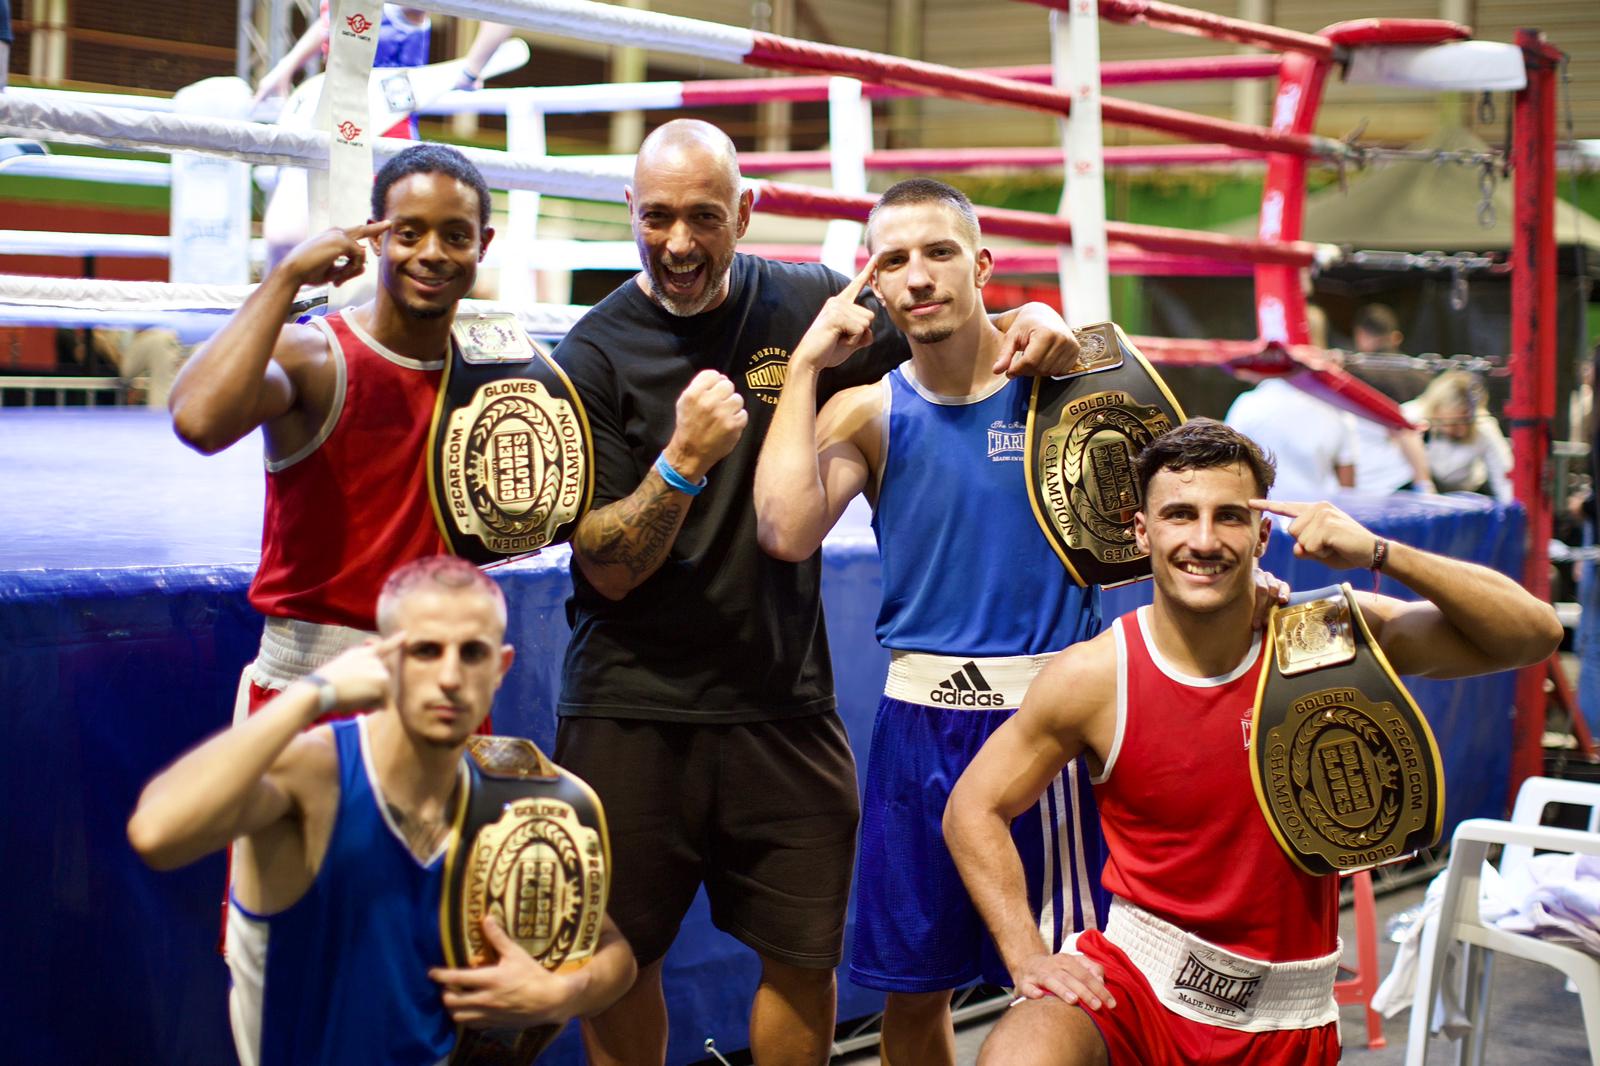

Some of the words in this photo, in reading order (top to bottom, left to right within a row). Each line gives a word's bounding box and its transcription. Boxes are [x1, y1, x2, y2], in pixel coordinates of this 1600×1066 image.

[751, 347, 787, 362] BOXING
[484, 382, 537, 398] GLOVES
[1069, 394, 1125, 416] GOLDEN
[557, 413, 580, 508] CHAMPION
[448, 428, 468, 518] F2CAR.COM
[1045, 442, 1079, 537] CHAMPION
[492, 533, 547, 549] GOLDEN
[930, 689, 1004, 706] adidas
[1295, 691, 1355, 714] GOLDEN
[1387, 717, 1422, 810] F2CAR.COM
[1271, 743, 1310, 841] CHAMPION
[514, 804, 568, 818] GOLDEN
[1339, 846, 1396, 866] GLOVES
[1197, 949, 1216, 962] The
[1175, 955, 1260, 1008] CHARLIE
[1178, 993, 1204, 1008] MADE
[1204, 1004, 1214, 1012] IN
[1215, 1007, 1237, 1018] HELL
